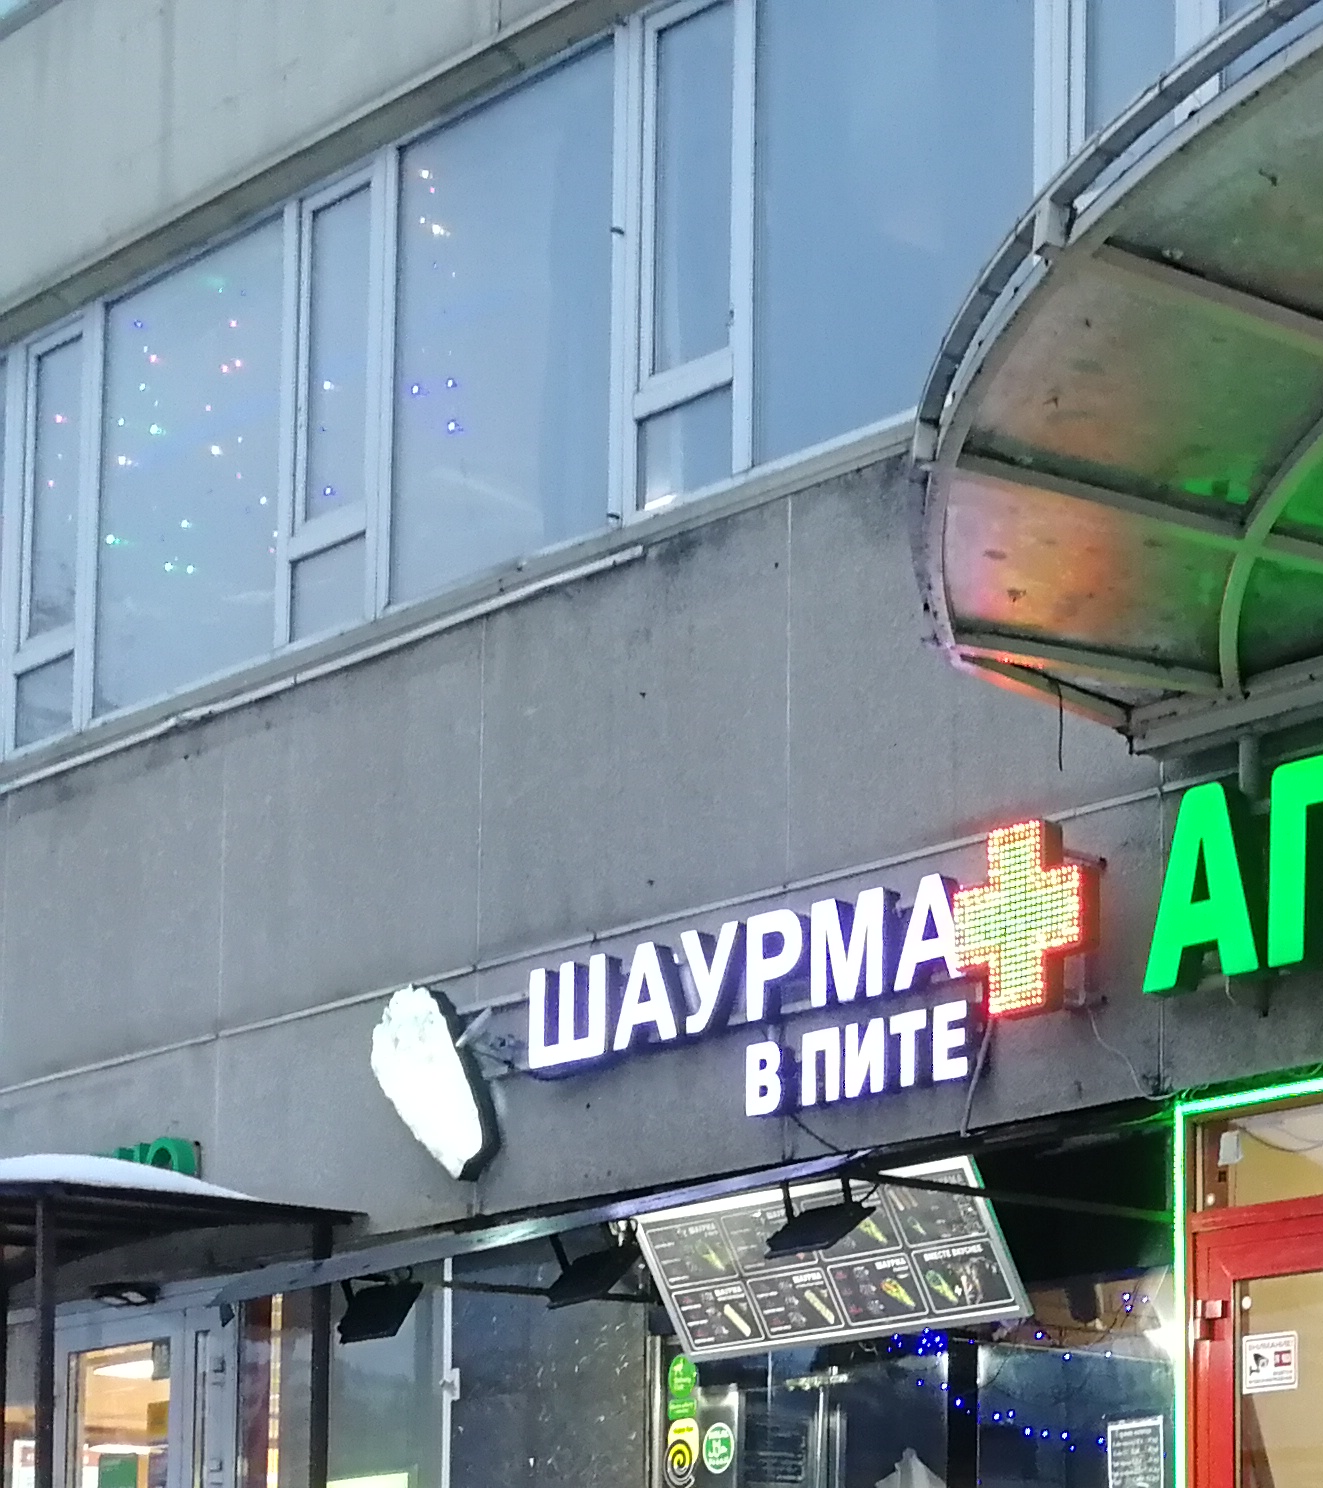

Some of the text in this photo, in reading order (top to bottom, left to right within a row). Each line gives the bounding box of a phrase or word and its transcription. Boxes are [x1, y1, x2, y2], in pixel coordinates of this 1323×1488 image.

[528, 873, 972, 1070] ШАУРМА
[745, 1000, 968, 1117] В ПИТЕ
